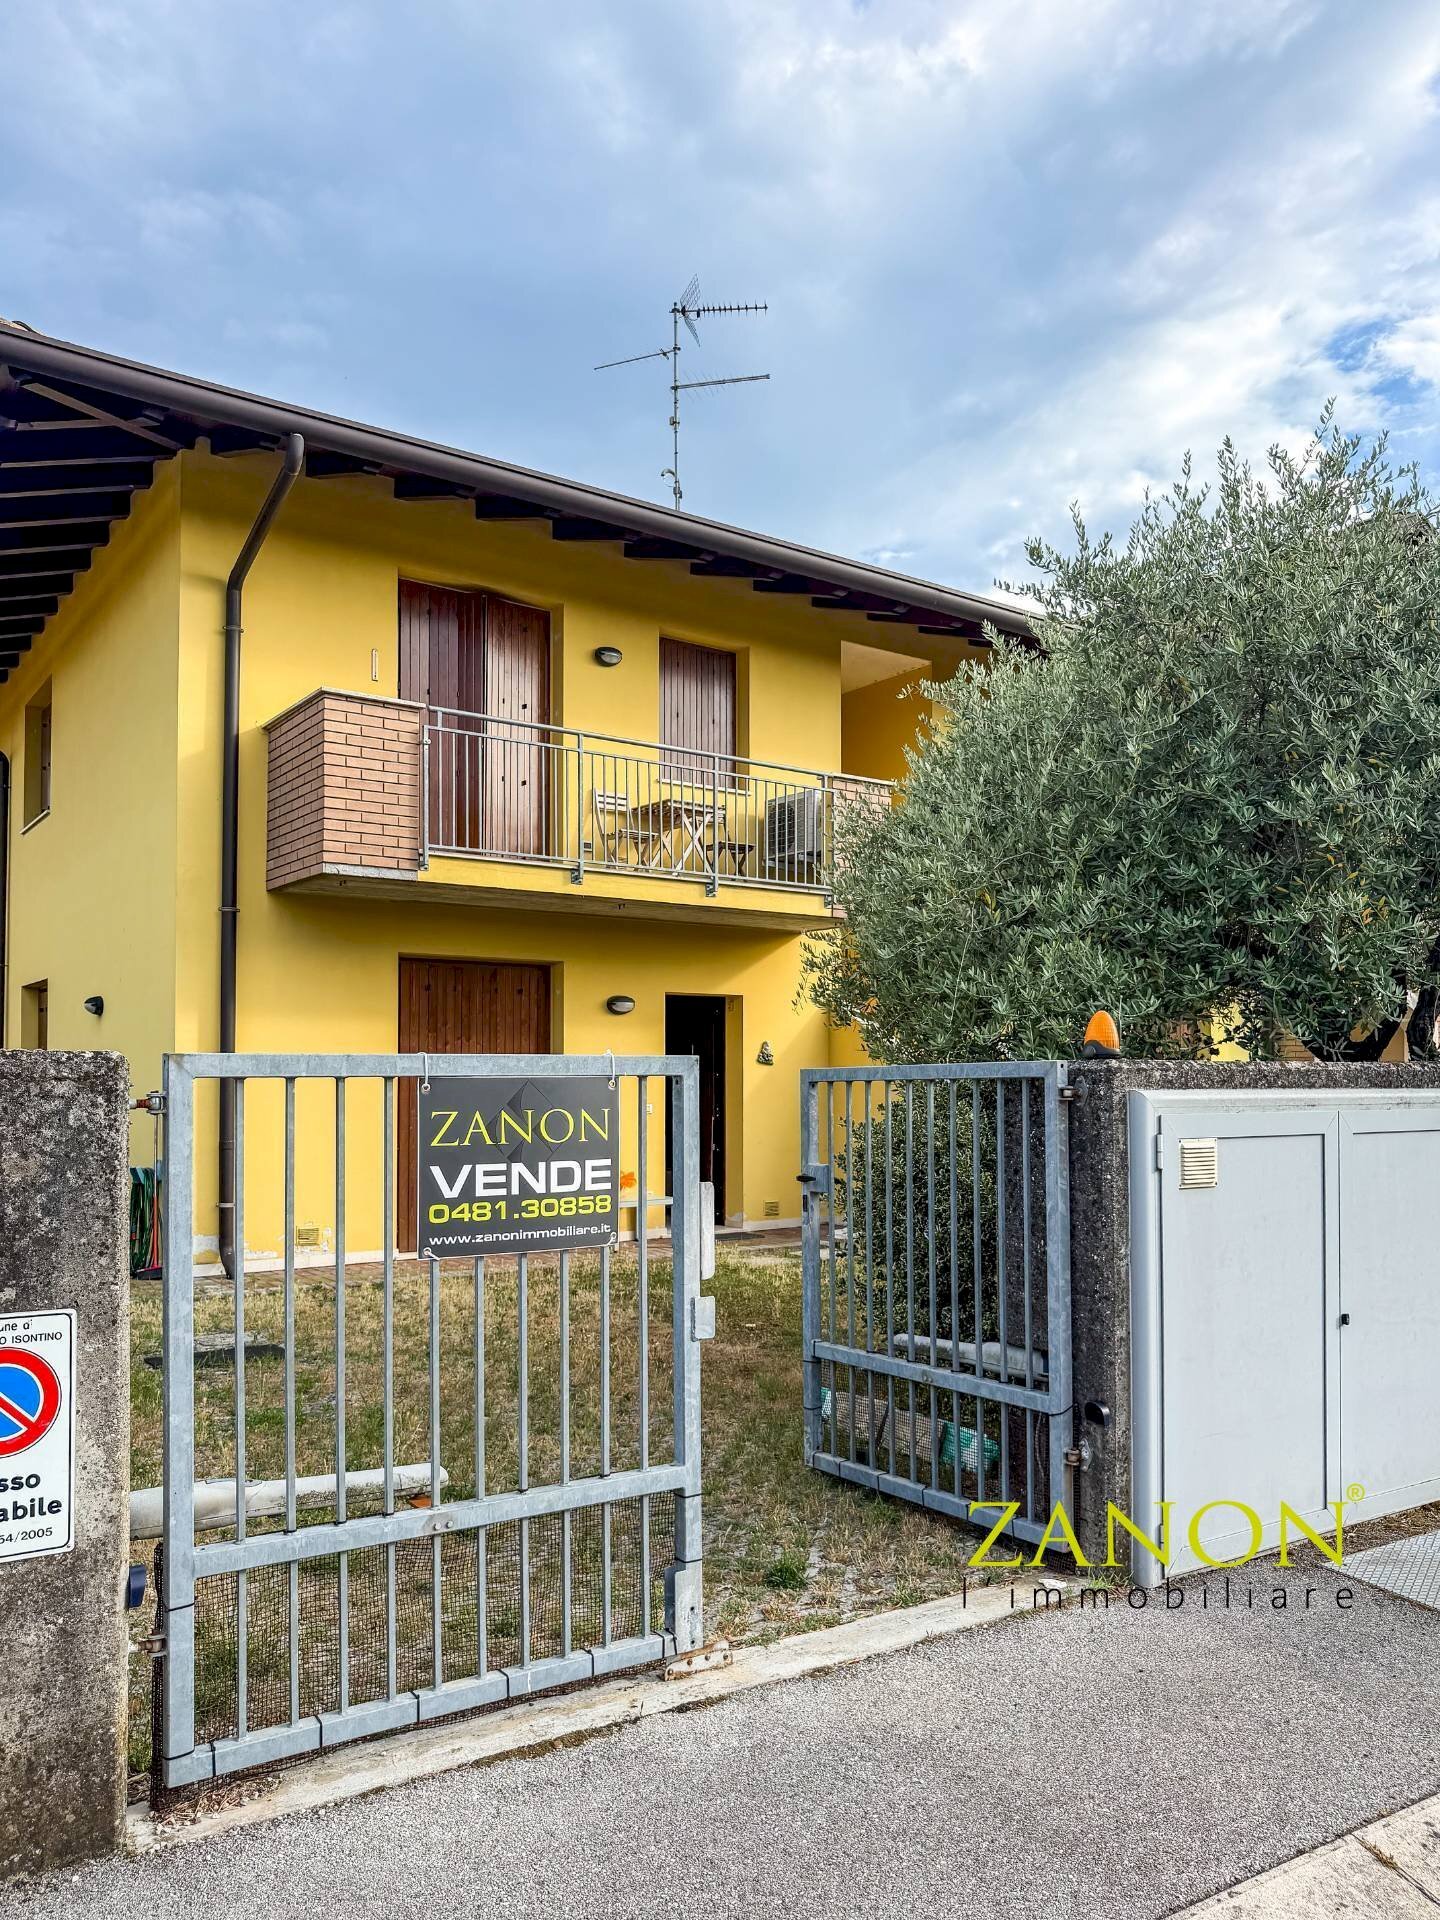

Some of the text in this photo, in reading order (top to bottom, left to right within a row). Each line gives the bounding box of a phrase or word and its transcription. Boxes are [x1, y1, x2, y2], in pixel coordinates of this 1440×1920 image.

[430, 1108, 611, 1147] ZANON
[429, 1158, 612, 1199] VENDE
[428, 1195, 612, 1224] 0481.30858
[429, 1223, 612, 1246] www.zanonimmobiliare.it
[11, 1331, 63, 1344] ISONTINO
